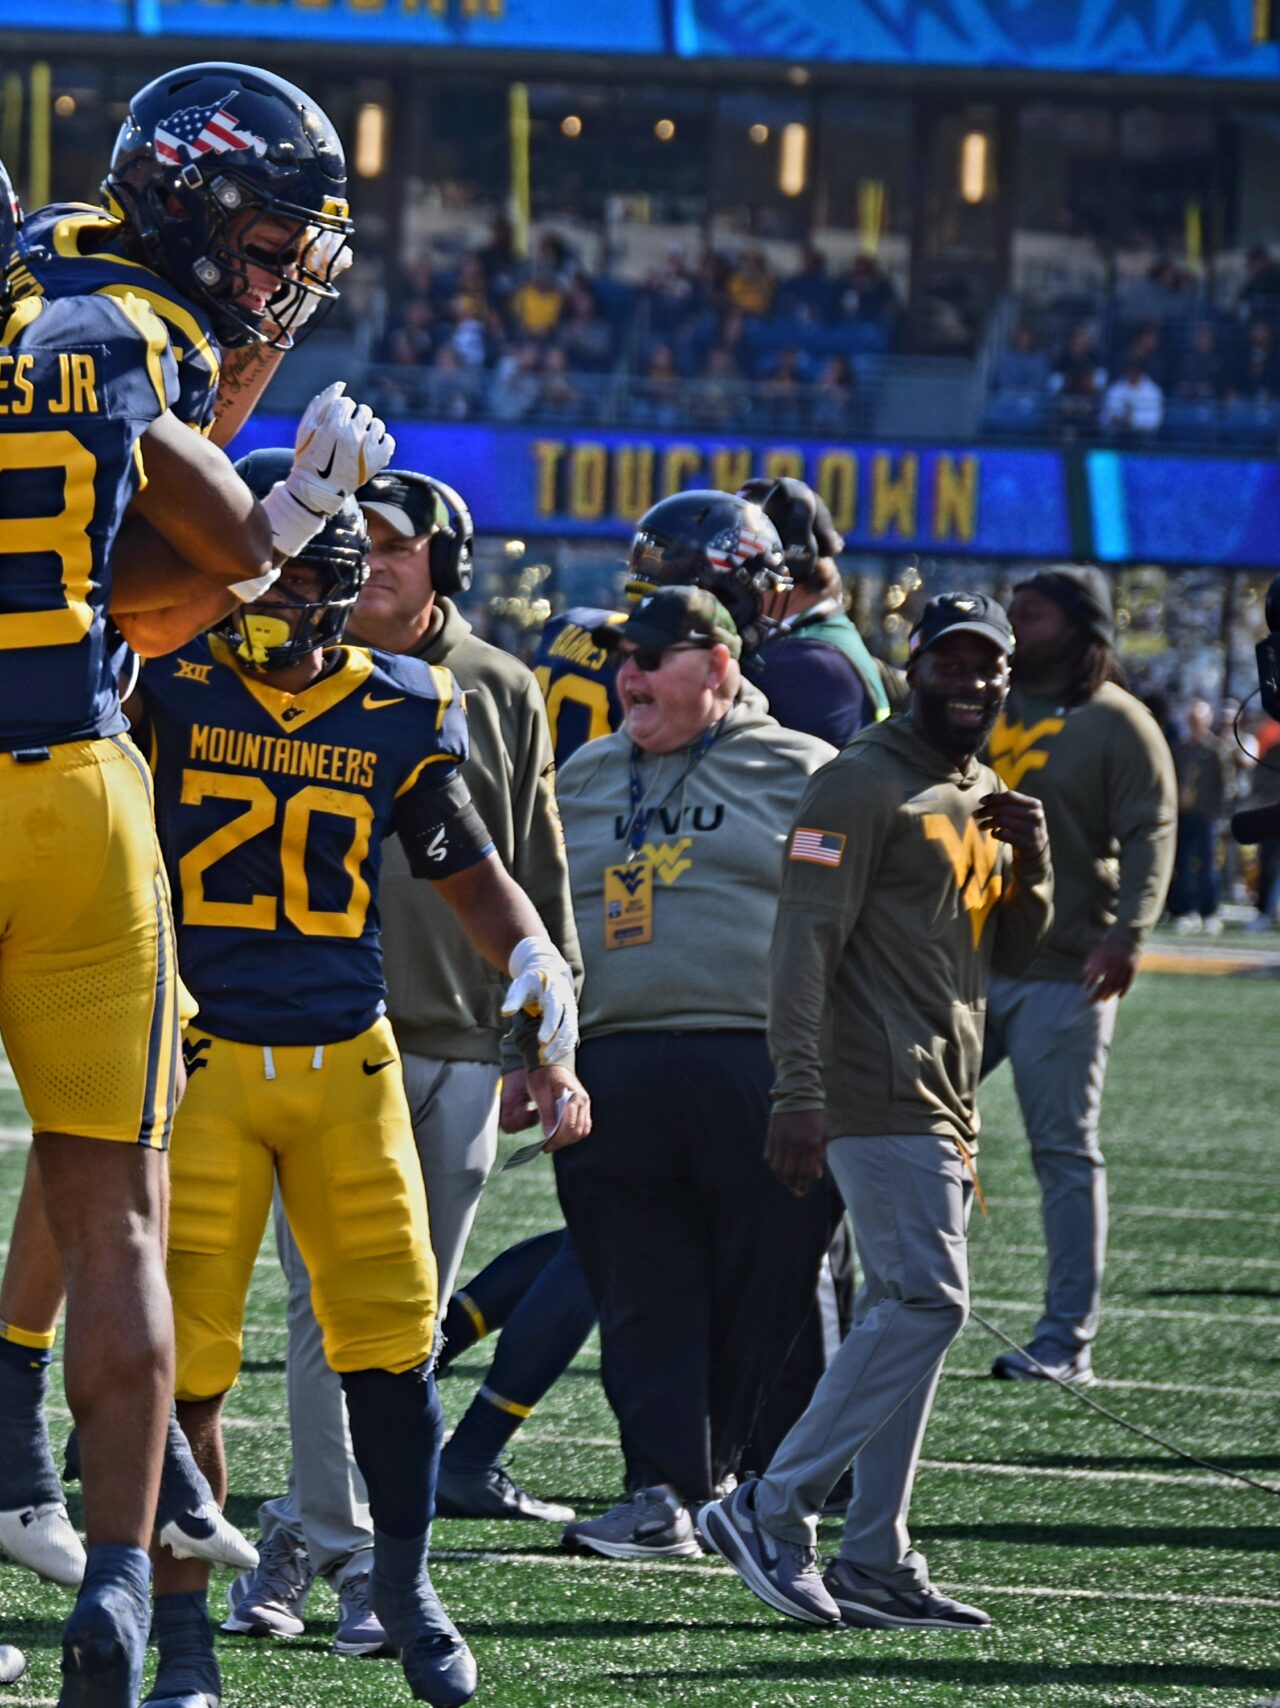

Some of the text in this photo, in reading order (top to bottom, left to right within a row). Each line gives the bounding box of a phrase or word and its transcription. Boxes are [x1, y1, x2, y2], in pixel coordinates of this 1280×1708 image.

[48, 353, 99, 413] JR
[190, 722, 377, 788] MOUNTAINEERS
[178, 767, 375, 939] 20
[614, 803, 725, 841] WVU
